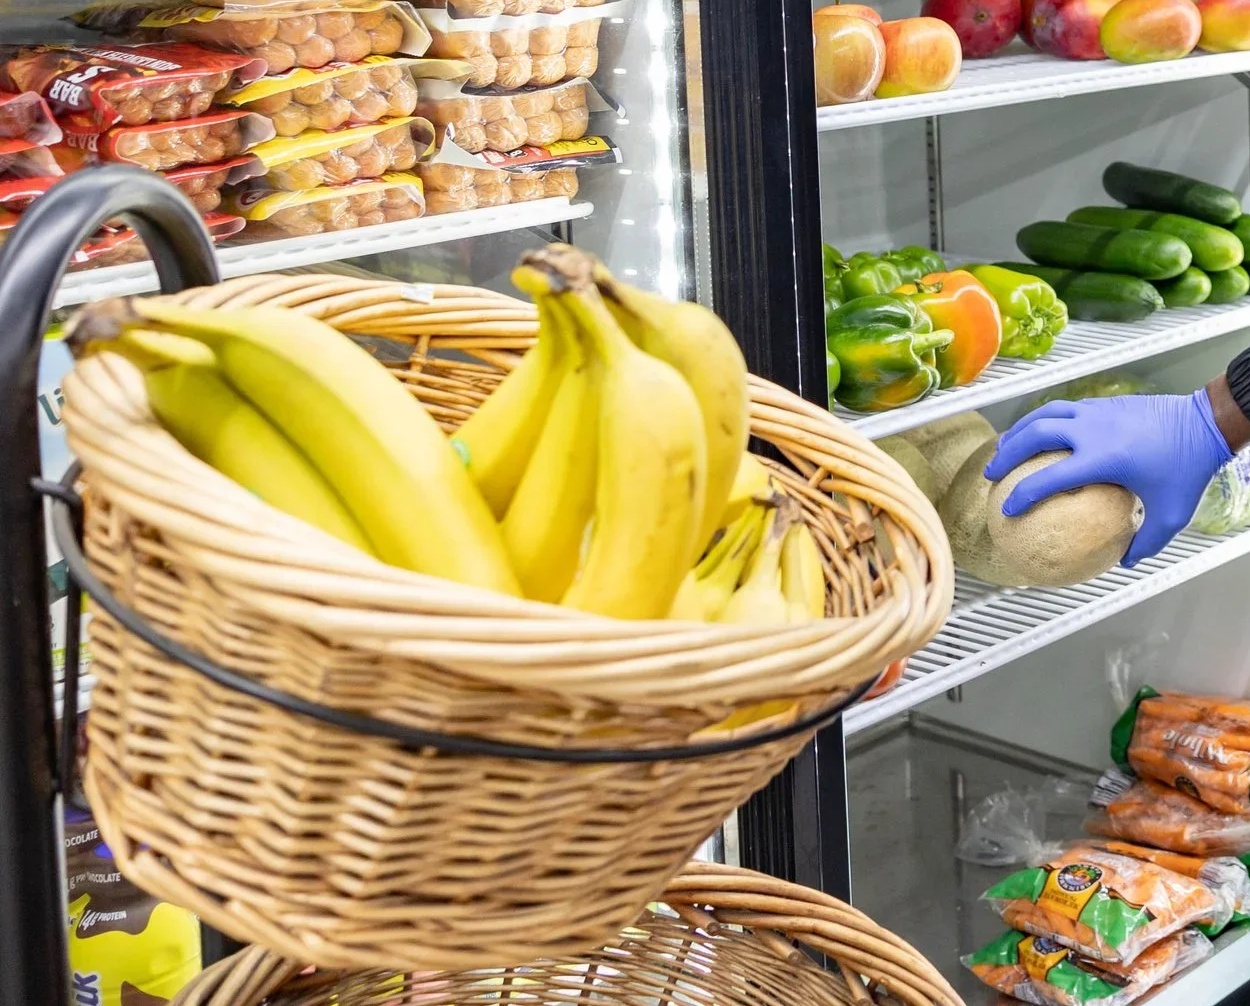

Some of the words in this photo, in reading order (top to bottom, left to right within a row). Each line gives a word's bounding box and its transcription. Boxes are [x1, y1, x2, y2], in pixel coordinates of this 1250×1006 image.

[49, 78, 84, 106] BAR
[67, 131, 100, 152] BAR
[65, 829, 99, 848] OCOLATE
[98, 910, 127, 922] PROTEIN
